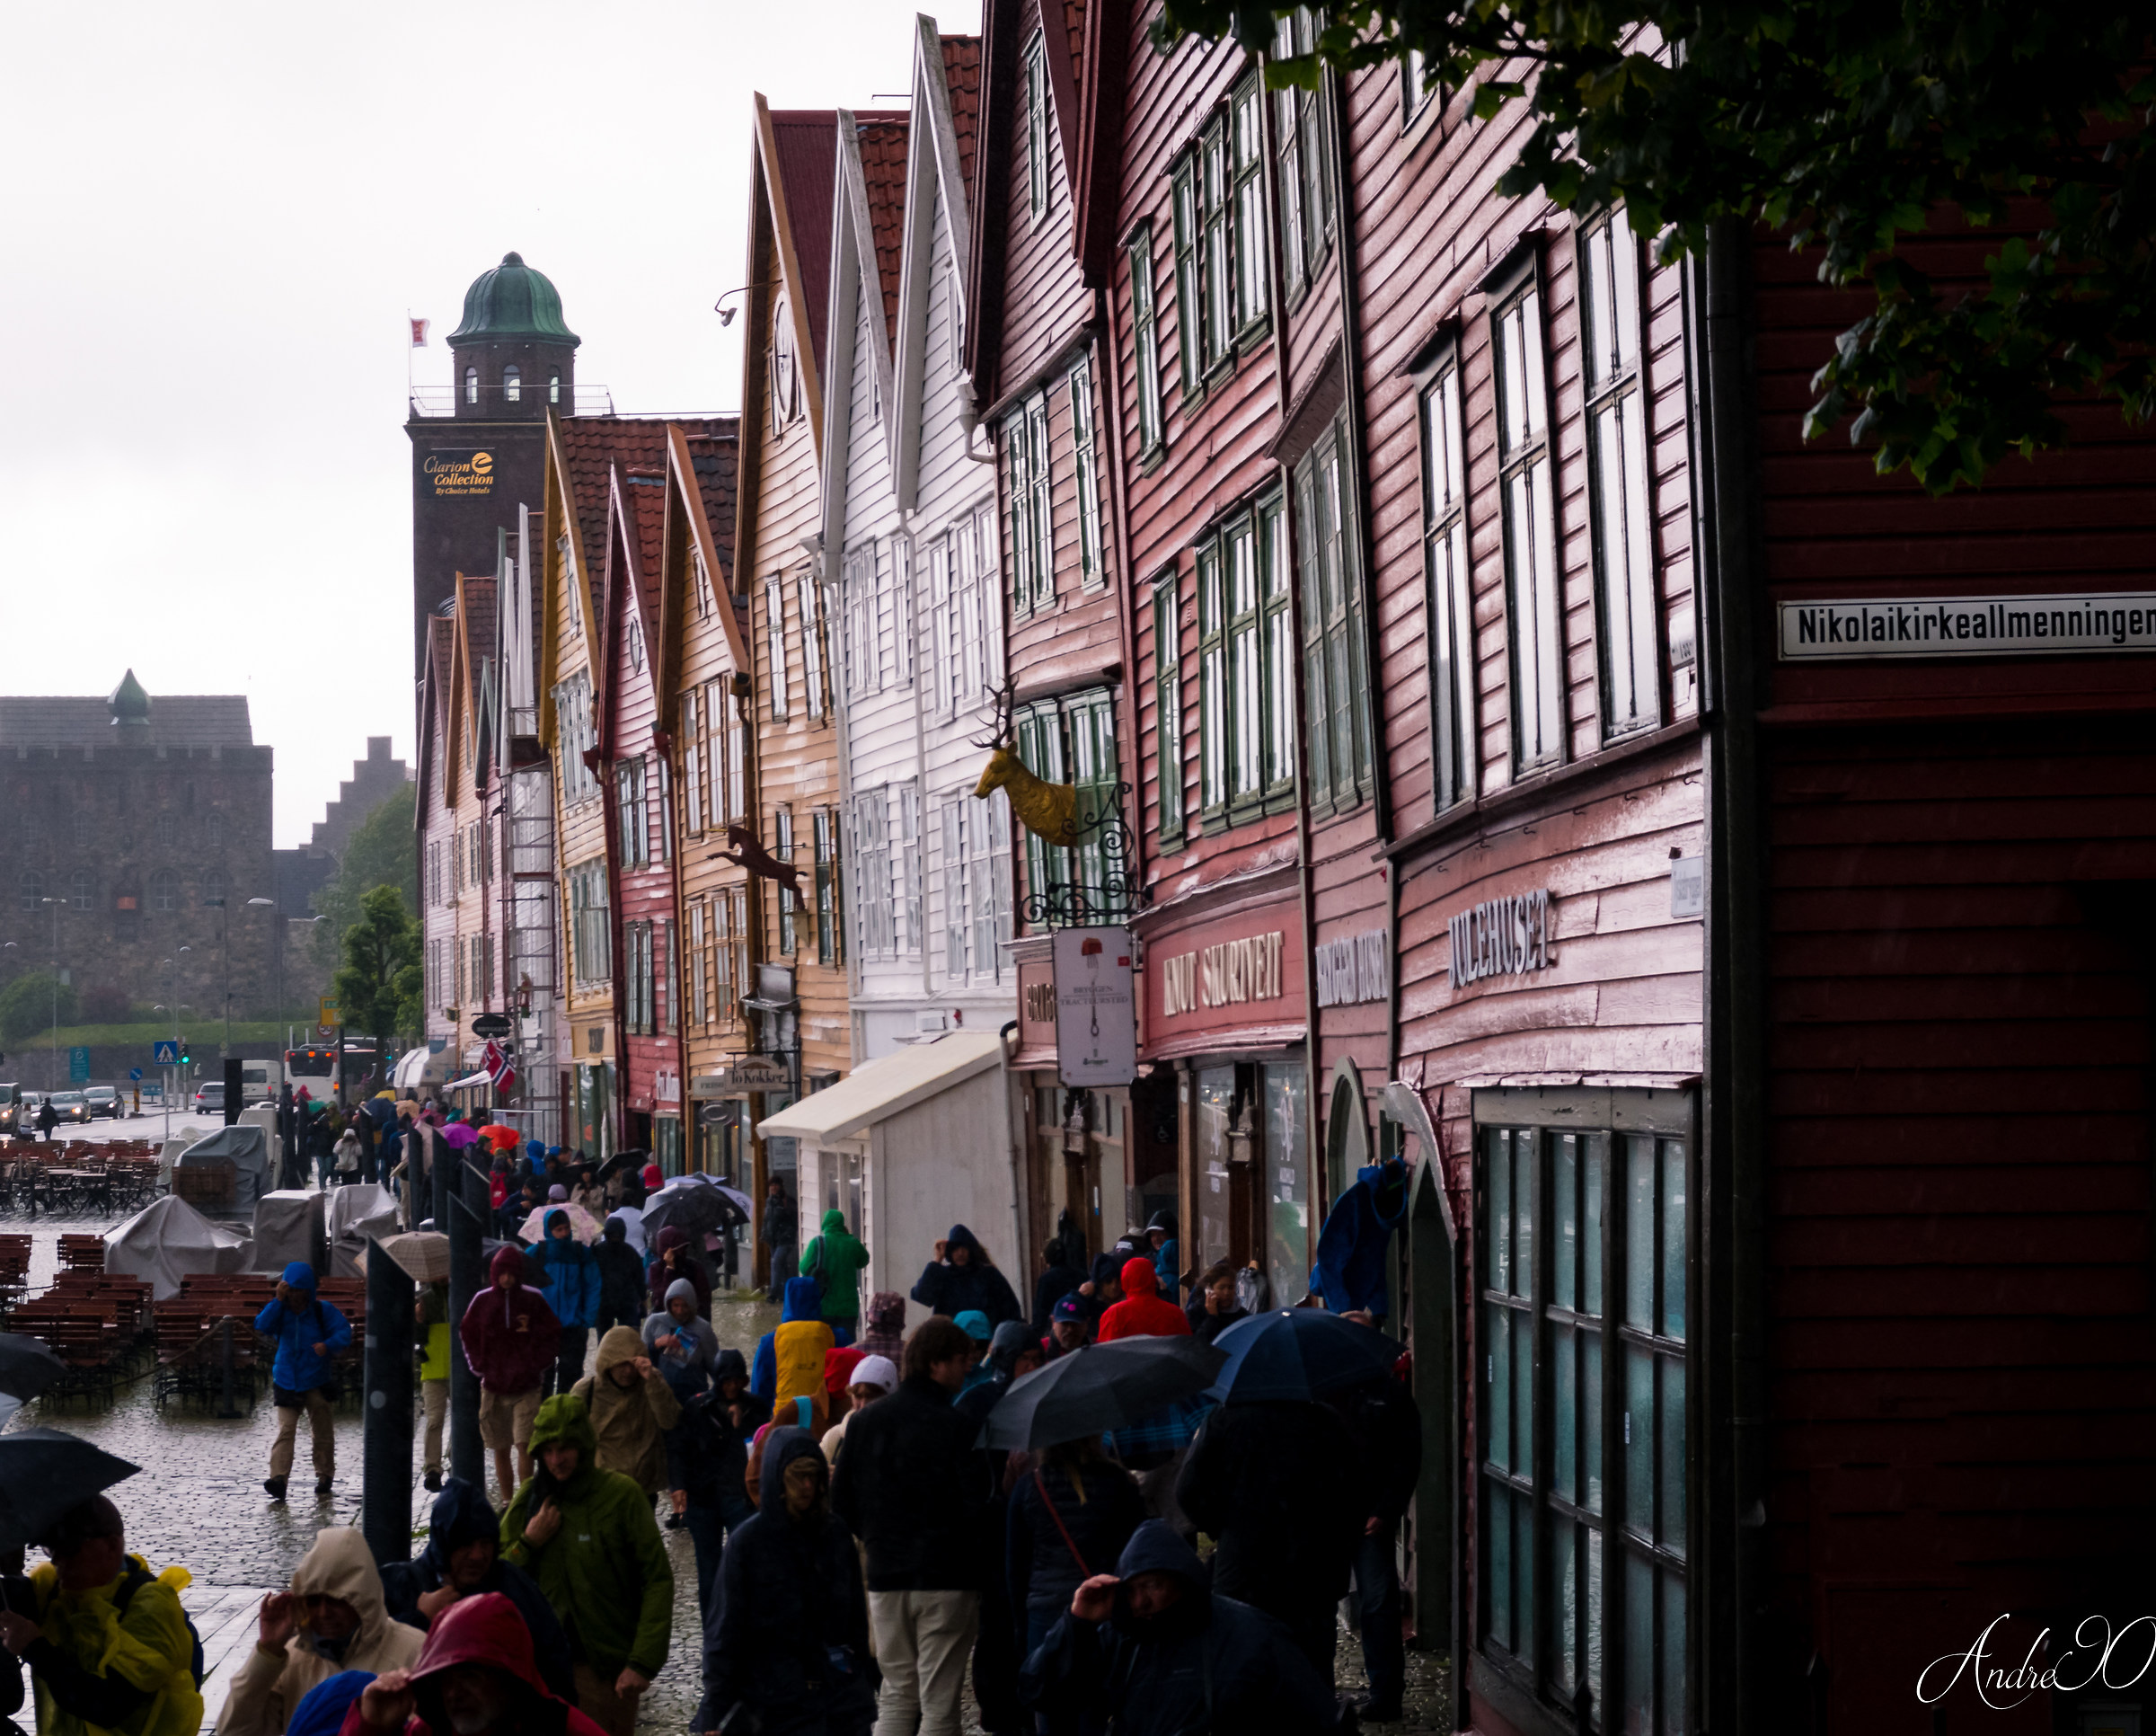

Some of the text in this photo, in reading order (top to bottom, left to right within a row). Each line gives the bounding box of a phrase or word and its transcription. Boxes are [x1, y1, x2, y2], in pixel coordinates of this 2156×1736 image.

[424, 456, 470, 474] Clarion
[434, 474, 493, 486] Collection
[436, 486, 490, 496] By Choice Hotels
[1798, 602, 2156, 644] Nikolaikirkeallmenningen
[1448, 888, 1551, 989] JULEHUSET
[1073, 985, 1113, 994] BRYGGEN
[1163, 950, 1199, 1016] KNUT
